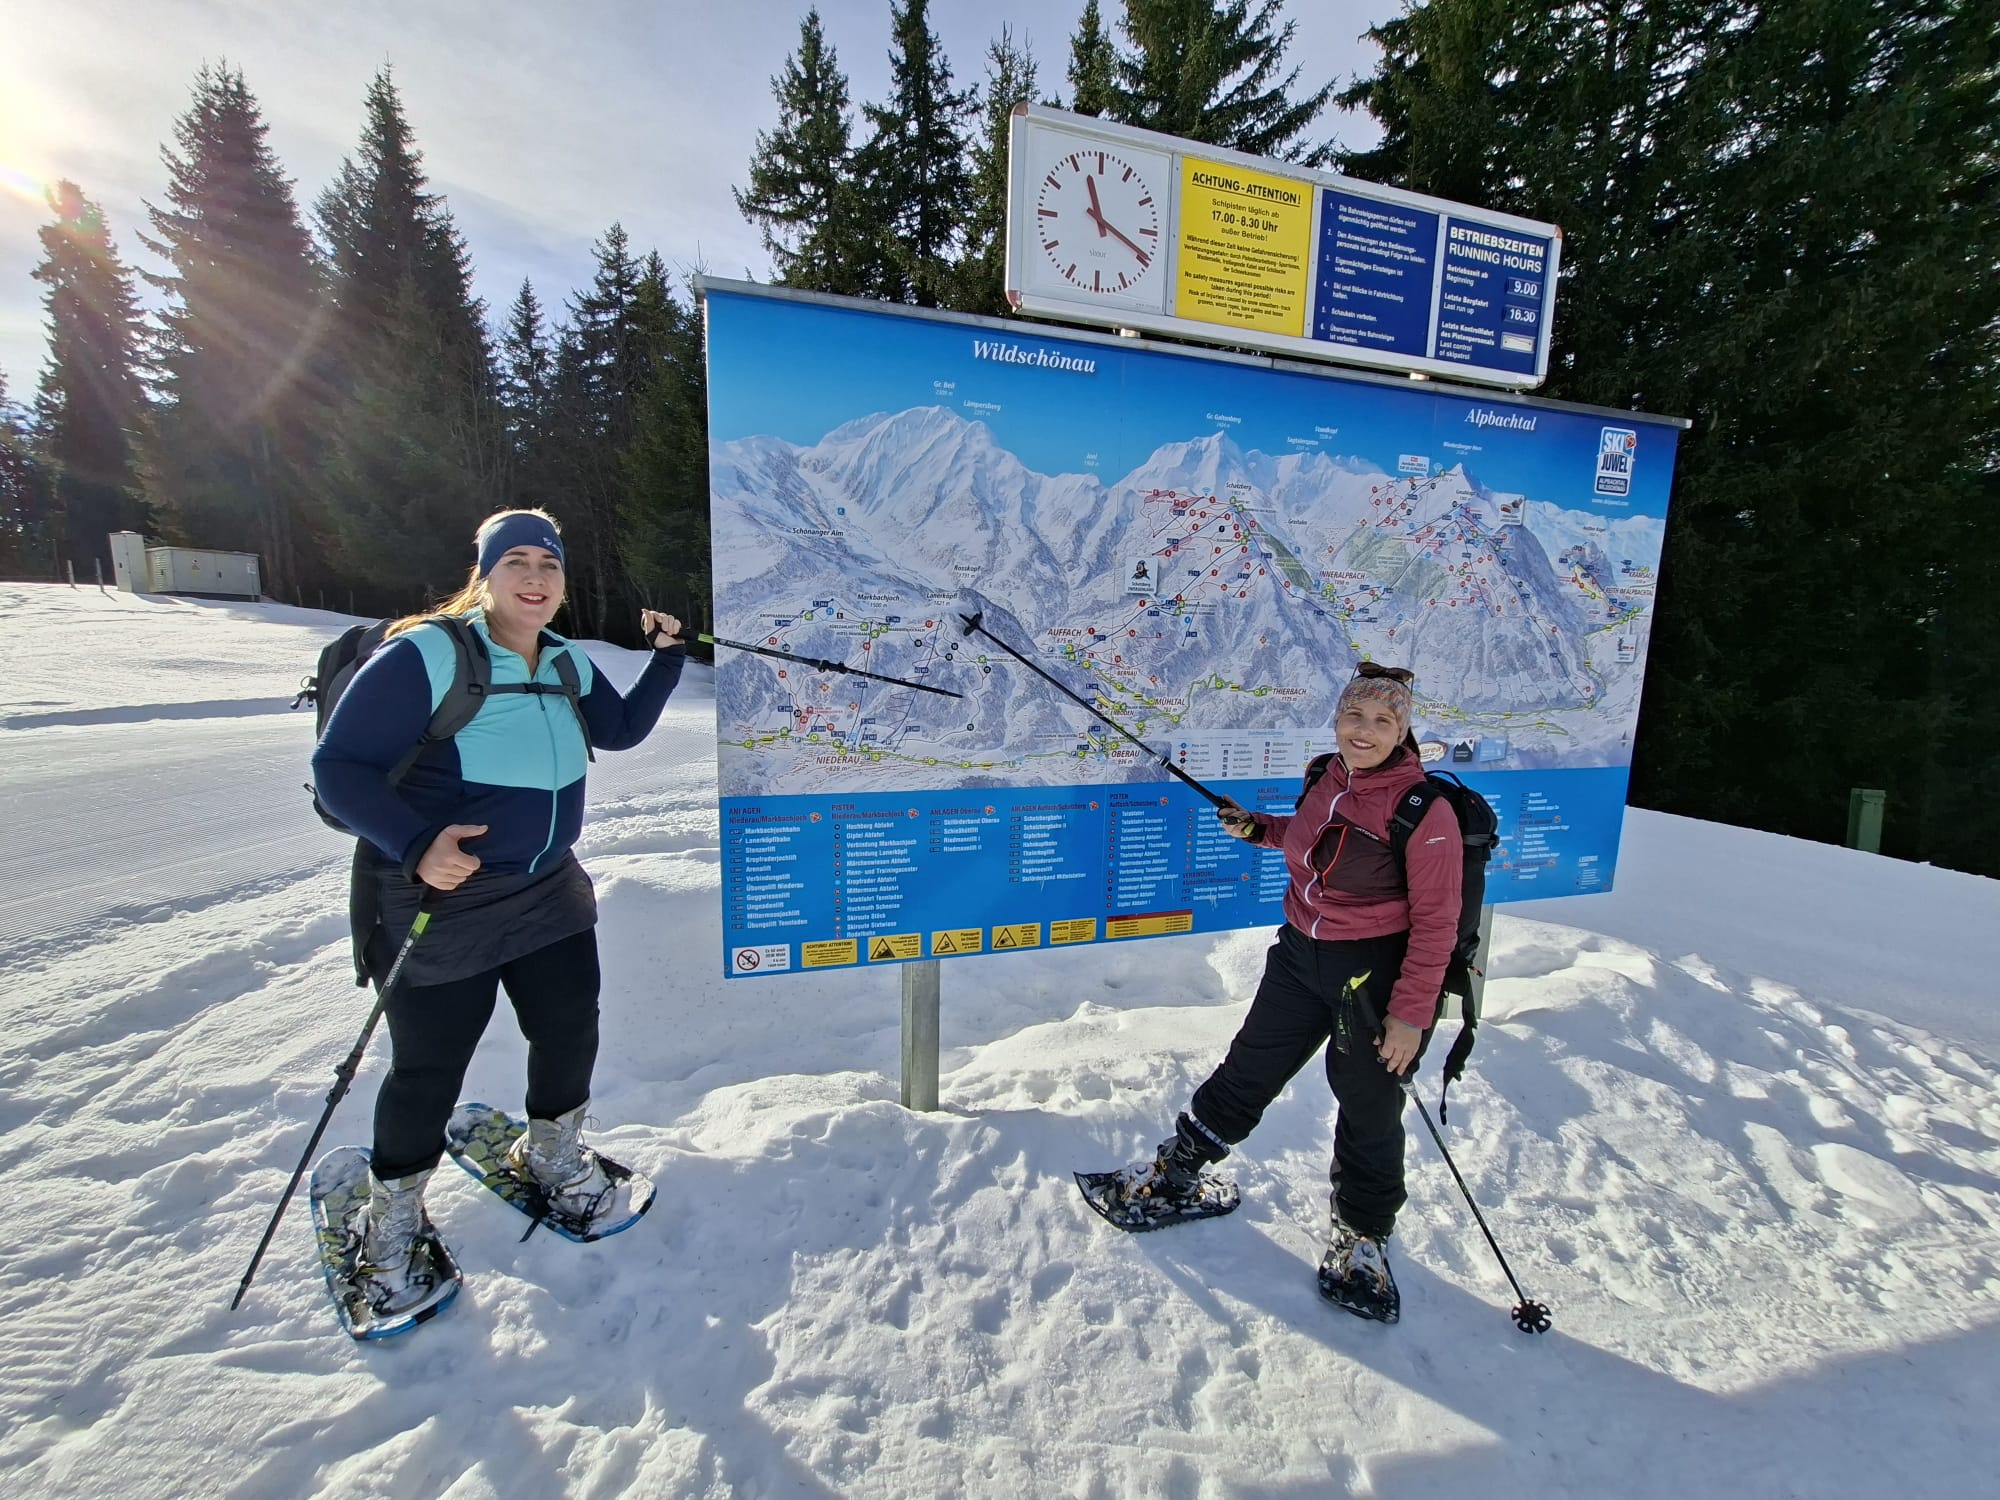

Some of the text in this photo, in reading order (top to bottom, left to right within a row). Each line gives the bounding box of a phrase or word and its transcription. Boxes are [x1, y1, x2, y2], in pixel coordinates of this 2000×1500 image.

[1262, 220, 1279, 233] Uhr
[1450, 227, 1544, 257] BETRIEBSZEITEN
[1449, 243, 1542, 273] RUNNING HOURS
[1193, 272, 1208, 282] safety
[1446, 273, 1475, 287] Beginning
[1225, 286, 1242, 296] during
[1444, 292, 1489, 308] Letzte Bergfahrt
[1443, 302, 1456, 310] Last
[1456, 305, 1466, 313] run
[1440, 330, 1451, 338] des
[1439, 340, 1473, 351] Last control
[972, 340, 1096, 373] Wildschönau
[1464, 407, 1537, 432] Alpbachtal
[1603, 431, 1625, 452] SKI
[1600, 453, 1628, 473] JUWEL
[1225, 480, 1252, 491] Schatzberg
[792, 527, 844, 538] Schönanger Alm
[1319, 570, 1366, 580] INNERALPBACH
[857, 593, 900, 602] Markbachjoch
[1048, 629, 1082, 637] AUFFACH
[1155, 698, 1185, 706] MÜHLTAL
[1111, 749, 1141, 758] OBERAU
[815, 755, 861, 765] NIEDERAU
